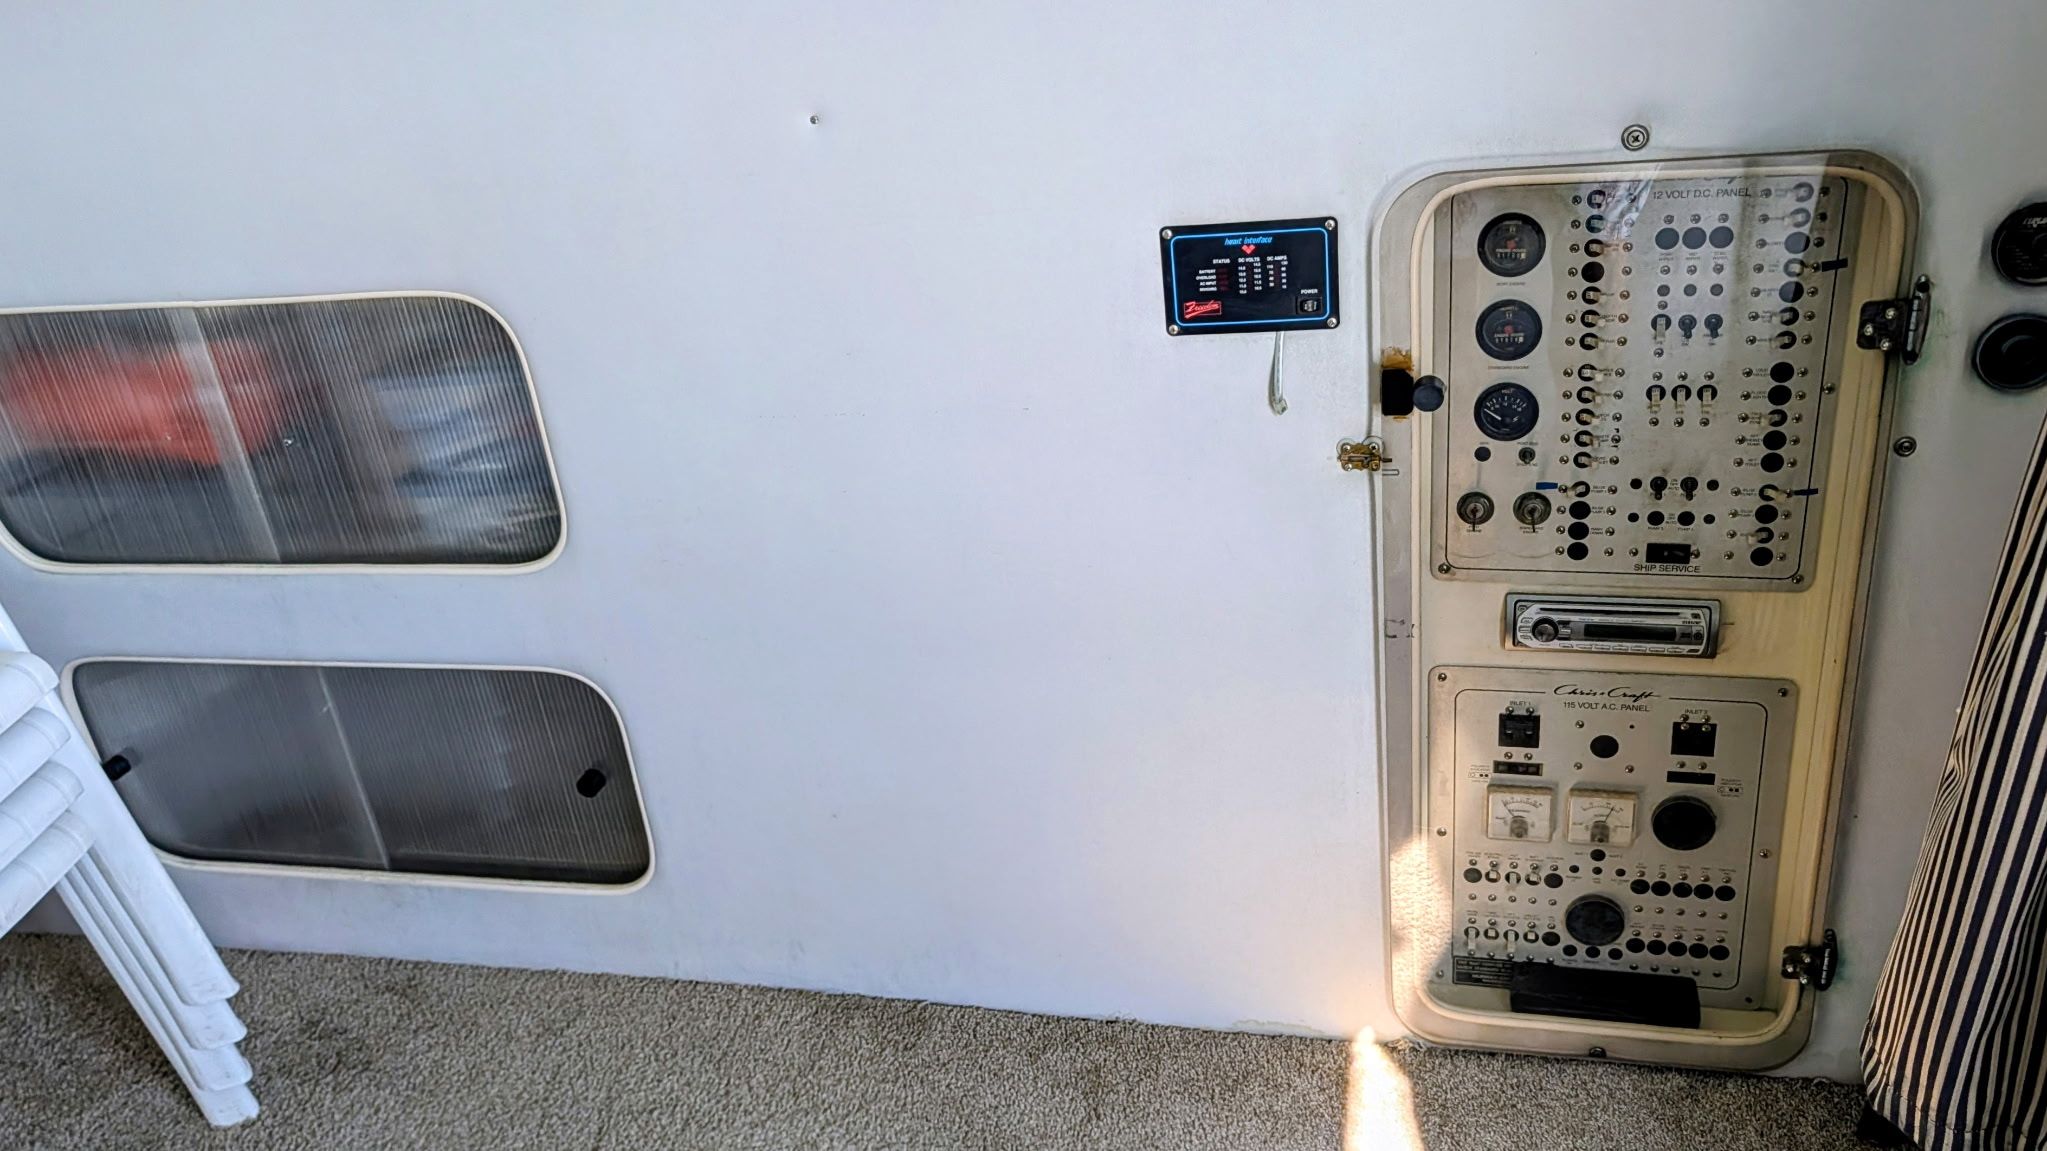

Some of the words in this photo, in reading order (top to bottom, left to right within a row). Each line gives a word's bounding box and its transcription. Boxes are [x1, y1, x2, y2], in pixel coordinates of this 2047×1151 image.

[1653, 191, 1664, 200] 12
[1665, 189, 1691, 199] VOLT
[1693, 189, 1713, 198] D.C.
[1716, 187, 1752, 198] PANEL
[1224, 238, 1242, 246] heart
[1243, 236, 1273, 244] interface
[1634, 564, 1657, 572] SHIP
[1658, 564, 1701, 573] SERVICE
[1577, 702, 1600, 710] VOLT
[1620, 704, 1651, 712] PANEL
